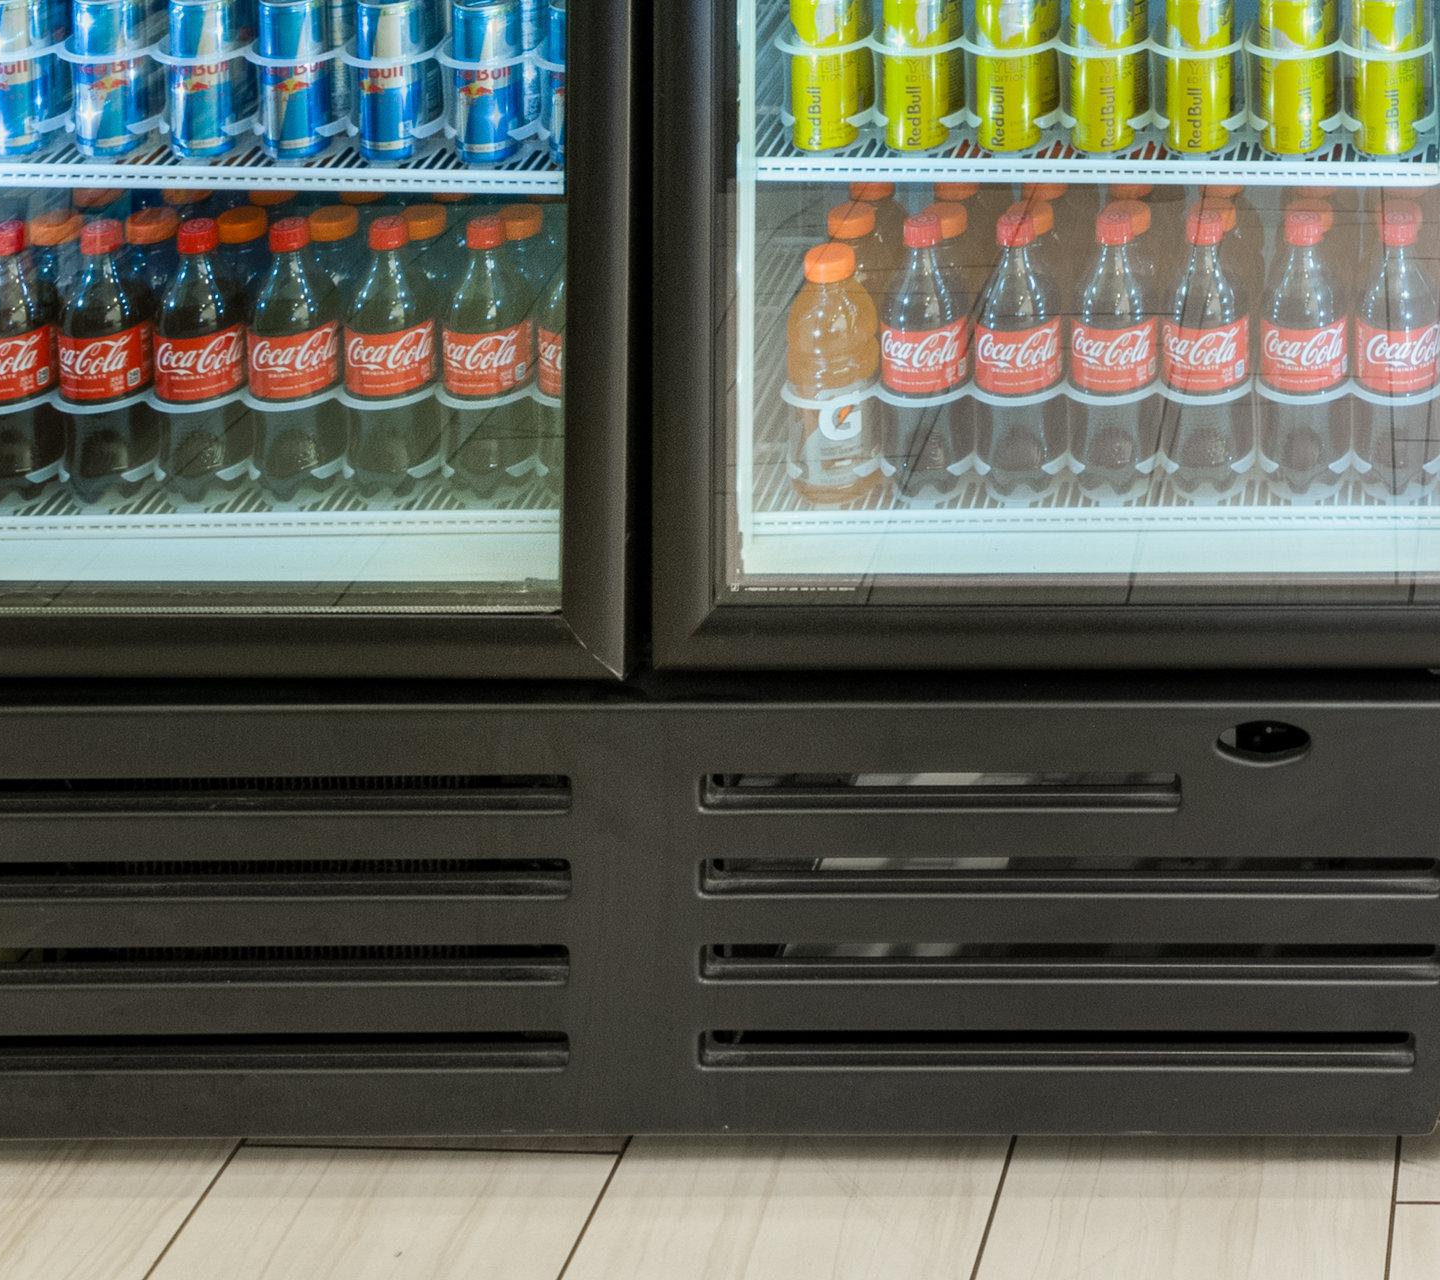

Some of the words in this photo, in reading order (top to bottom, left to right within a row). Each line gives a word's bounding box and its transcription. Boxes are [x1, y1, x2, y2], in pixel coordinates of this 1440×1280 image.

[907, 86, 921, 113] Bull
[991, 85, 1005, 113] Bull
[1101, 86, 1115, 115] Bull
[1188, 87, 1202, 114] Bull
[907, 115, 921, 146] Red
[991, 115, 1005, 146] Red
[1101, 118, 1115, 147] Red
[1188, 117, 1202, 148] Red
[158, 331, 241, 375] Coca-Cola
[252, 327, 337, 371] Coca-Cola
[348, 327, 433, 370] Coca-Cola
[881, 327, 960, 367] Coca-Cola
[978, 327, 1058, 369] Coca-Cola
[1072, 326, 1151, 366] Coca-Cola
[1264, 326, 1345, 366] Coca-Cola
[819, 395, 862, 440] G
